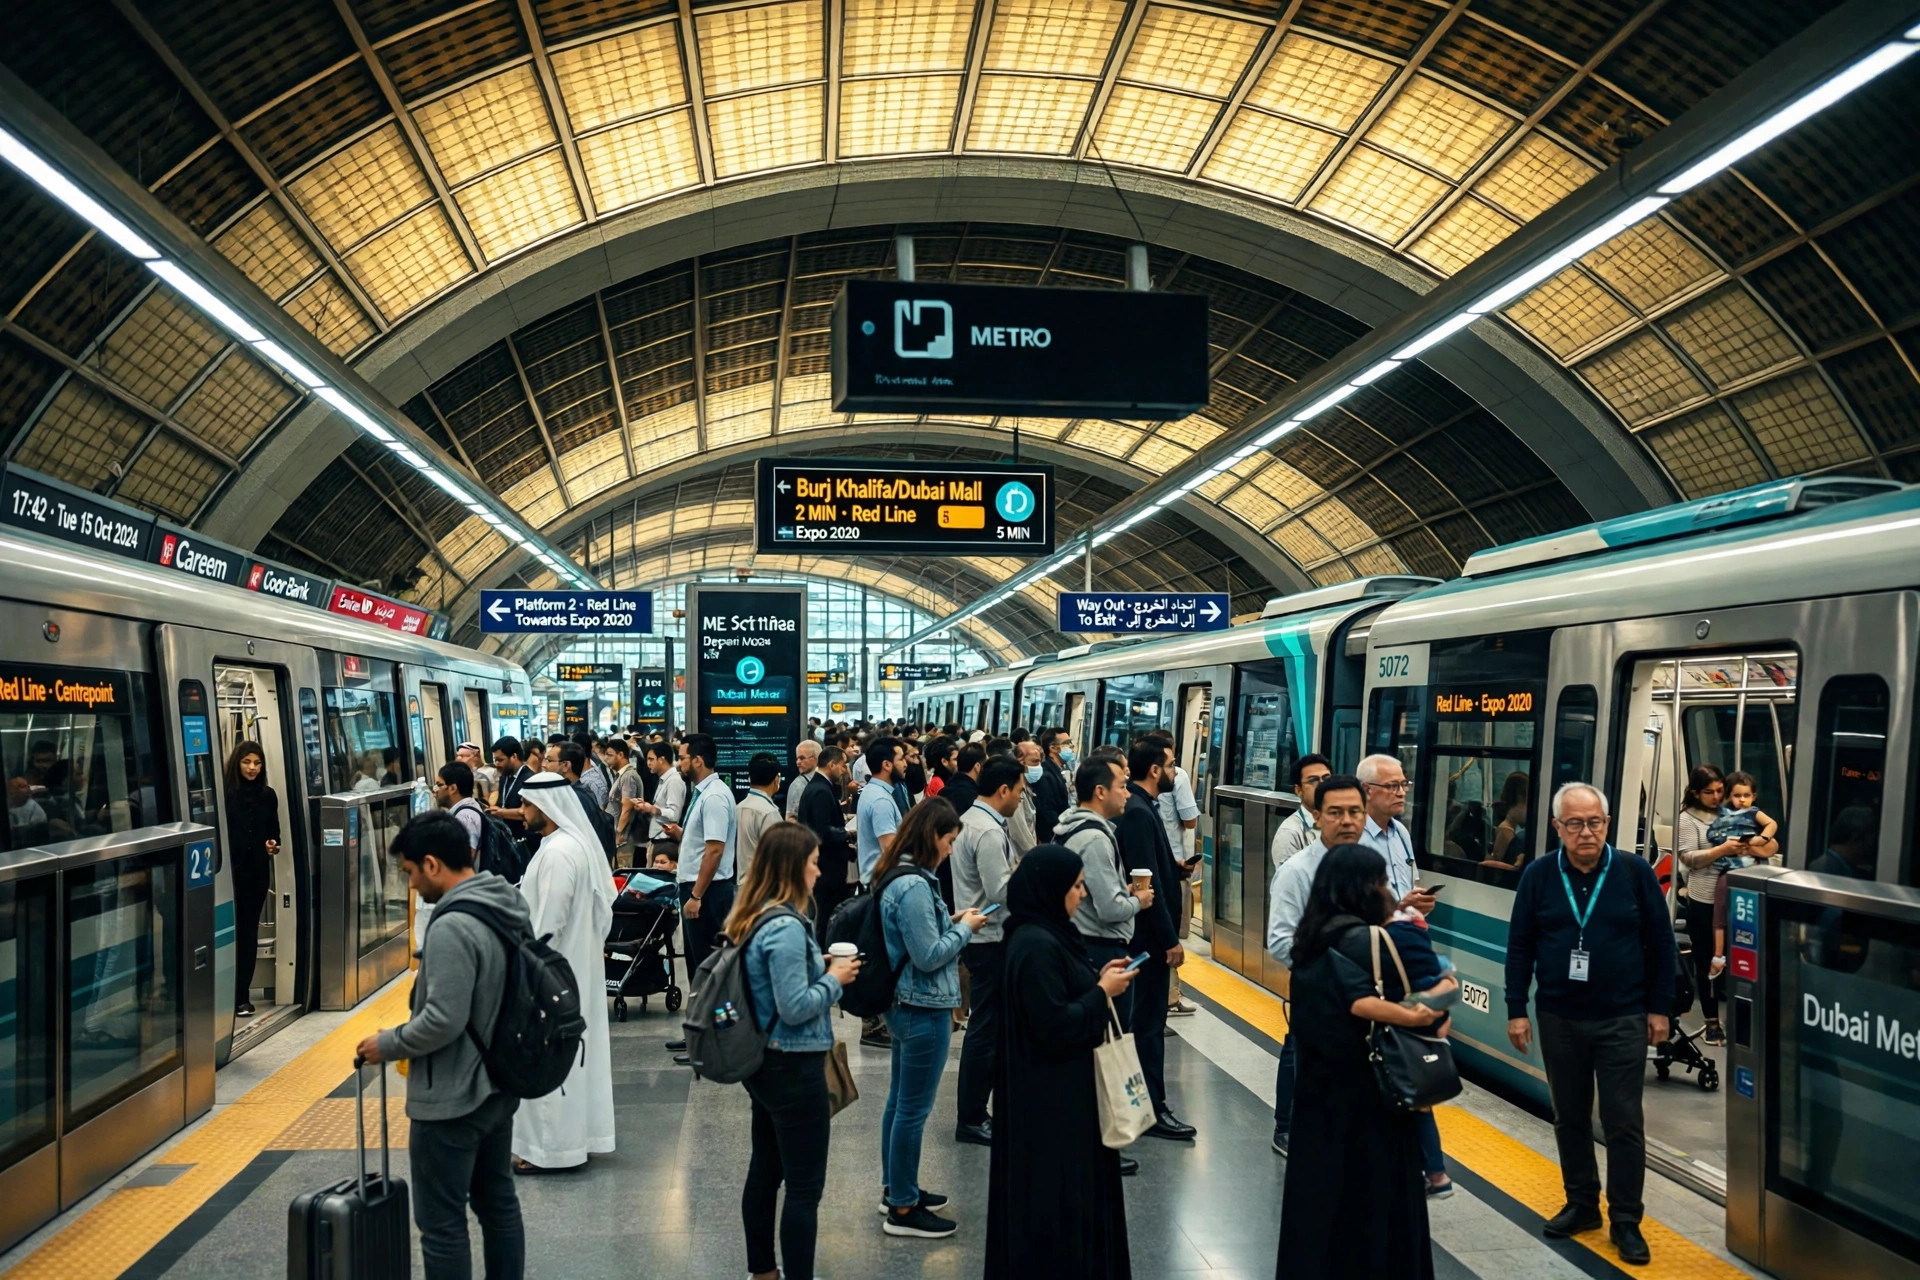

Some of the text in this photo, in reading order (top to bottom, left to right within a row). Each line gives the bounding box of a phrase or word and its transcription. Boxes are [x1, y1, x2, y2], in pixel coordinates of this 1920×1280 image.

[971, 325, 1052, 348] METRO
[796, 477, 983, 503] Burj Khalifa/Dubai Mall
[13, 489, 139, 549] 17:42 Tue 15 Oct 2024
[795, 504, 917, 523] 2 MIN Red Line
[796, 526, 861, 542] Expo 2020
[996, 526, 1030, 540] 5 MIN
[176, 540, 227, 581] Careem
[515, 597, 637, 611] Platform 2 Red Line
[1076, 598, 1126, 614] Way Out
[515, 613, 633, 629] Towards Expo 2020
[1078, 613, 1117, 627] To Exit
[1379, 654, 1410, 678] 5072
[22, 677, 47, 701] Line
[1436, 693, 1533, 717] Red Line Expo 2020
[1464, 984, 1488, 1009] 5072
[1803, 992, 1870, 1045] Dubai
